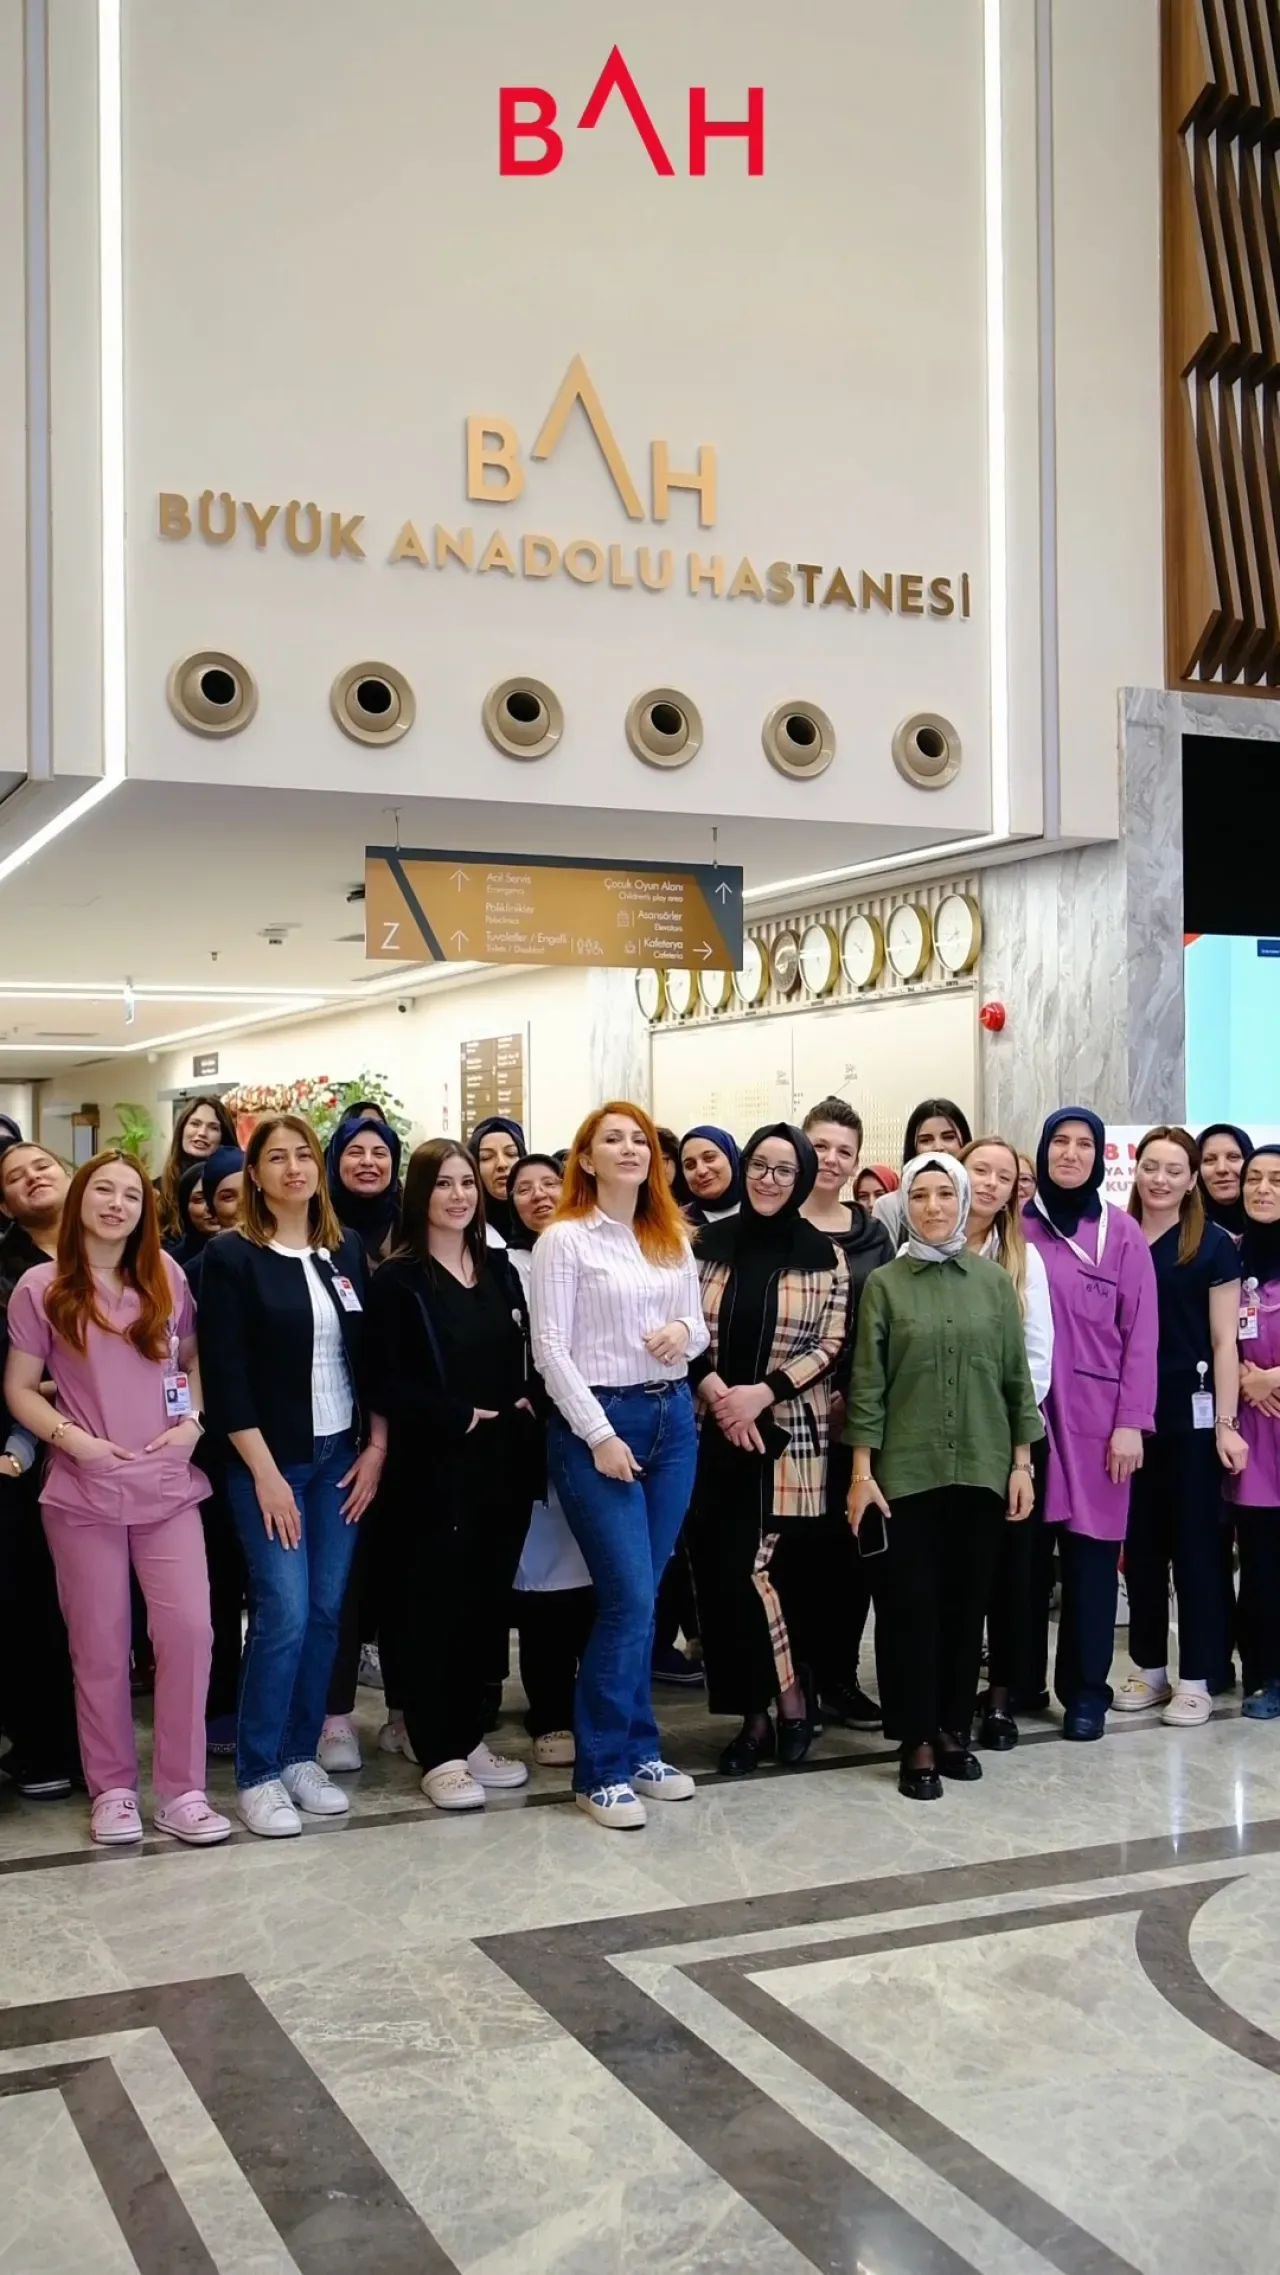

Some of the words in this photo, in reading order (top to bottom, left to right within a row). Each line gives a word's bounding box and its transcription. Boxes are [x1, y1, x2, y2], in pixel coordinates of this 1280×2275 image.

[466, 353, 718, 528] BAH
[158, 489, 367, 558] BÜYÜK
[388, 519, 673, 591] ANADOLU
[687, 550, 972, 621] HASTANESİ
[506, 873, 531, 885] Servis
[604, 877, 632, 891] Çocuk
[634, 879, 660, 892] Oyun
[638, 910, 683, 921] Asansörler
[381, 923, 400, 950] Z
[643, 937, 684, 951] Kafeterya
[1105, 1181, 1133, 1193] KU
